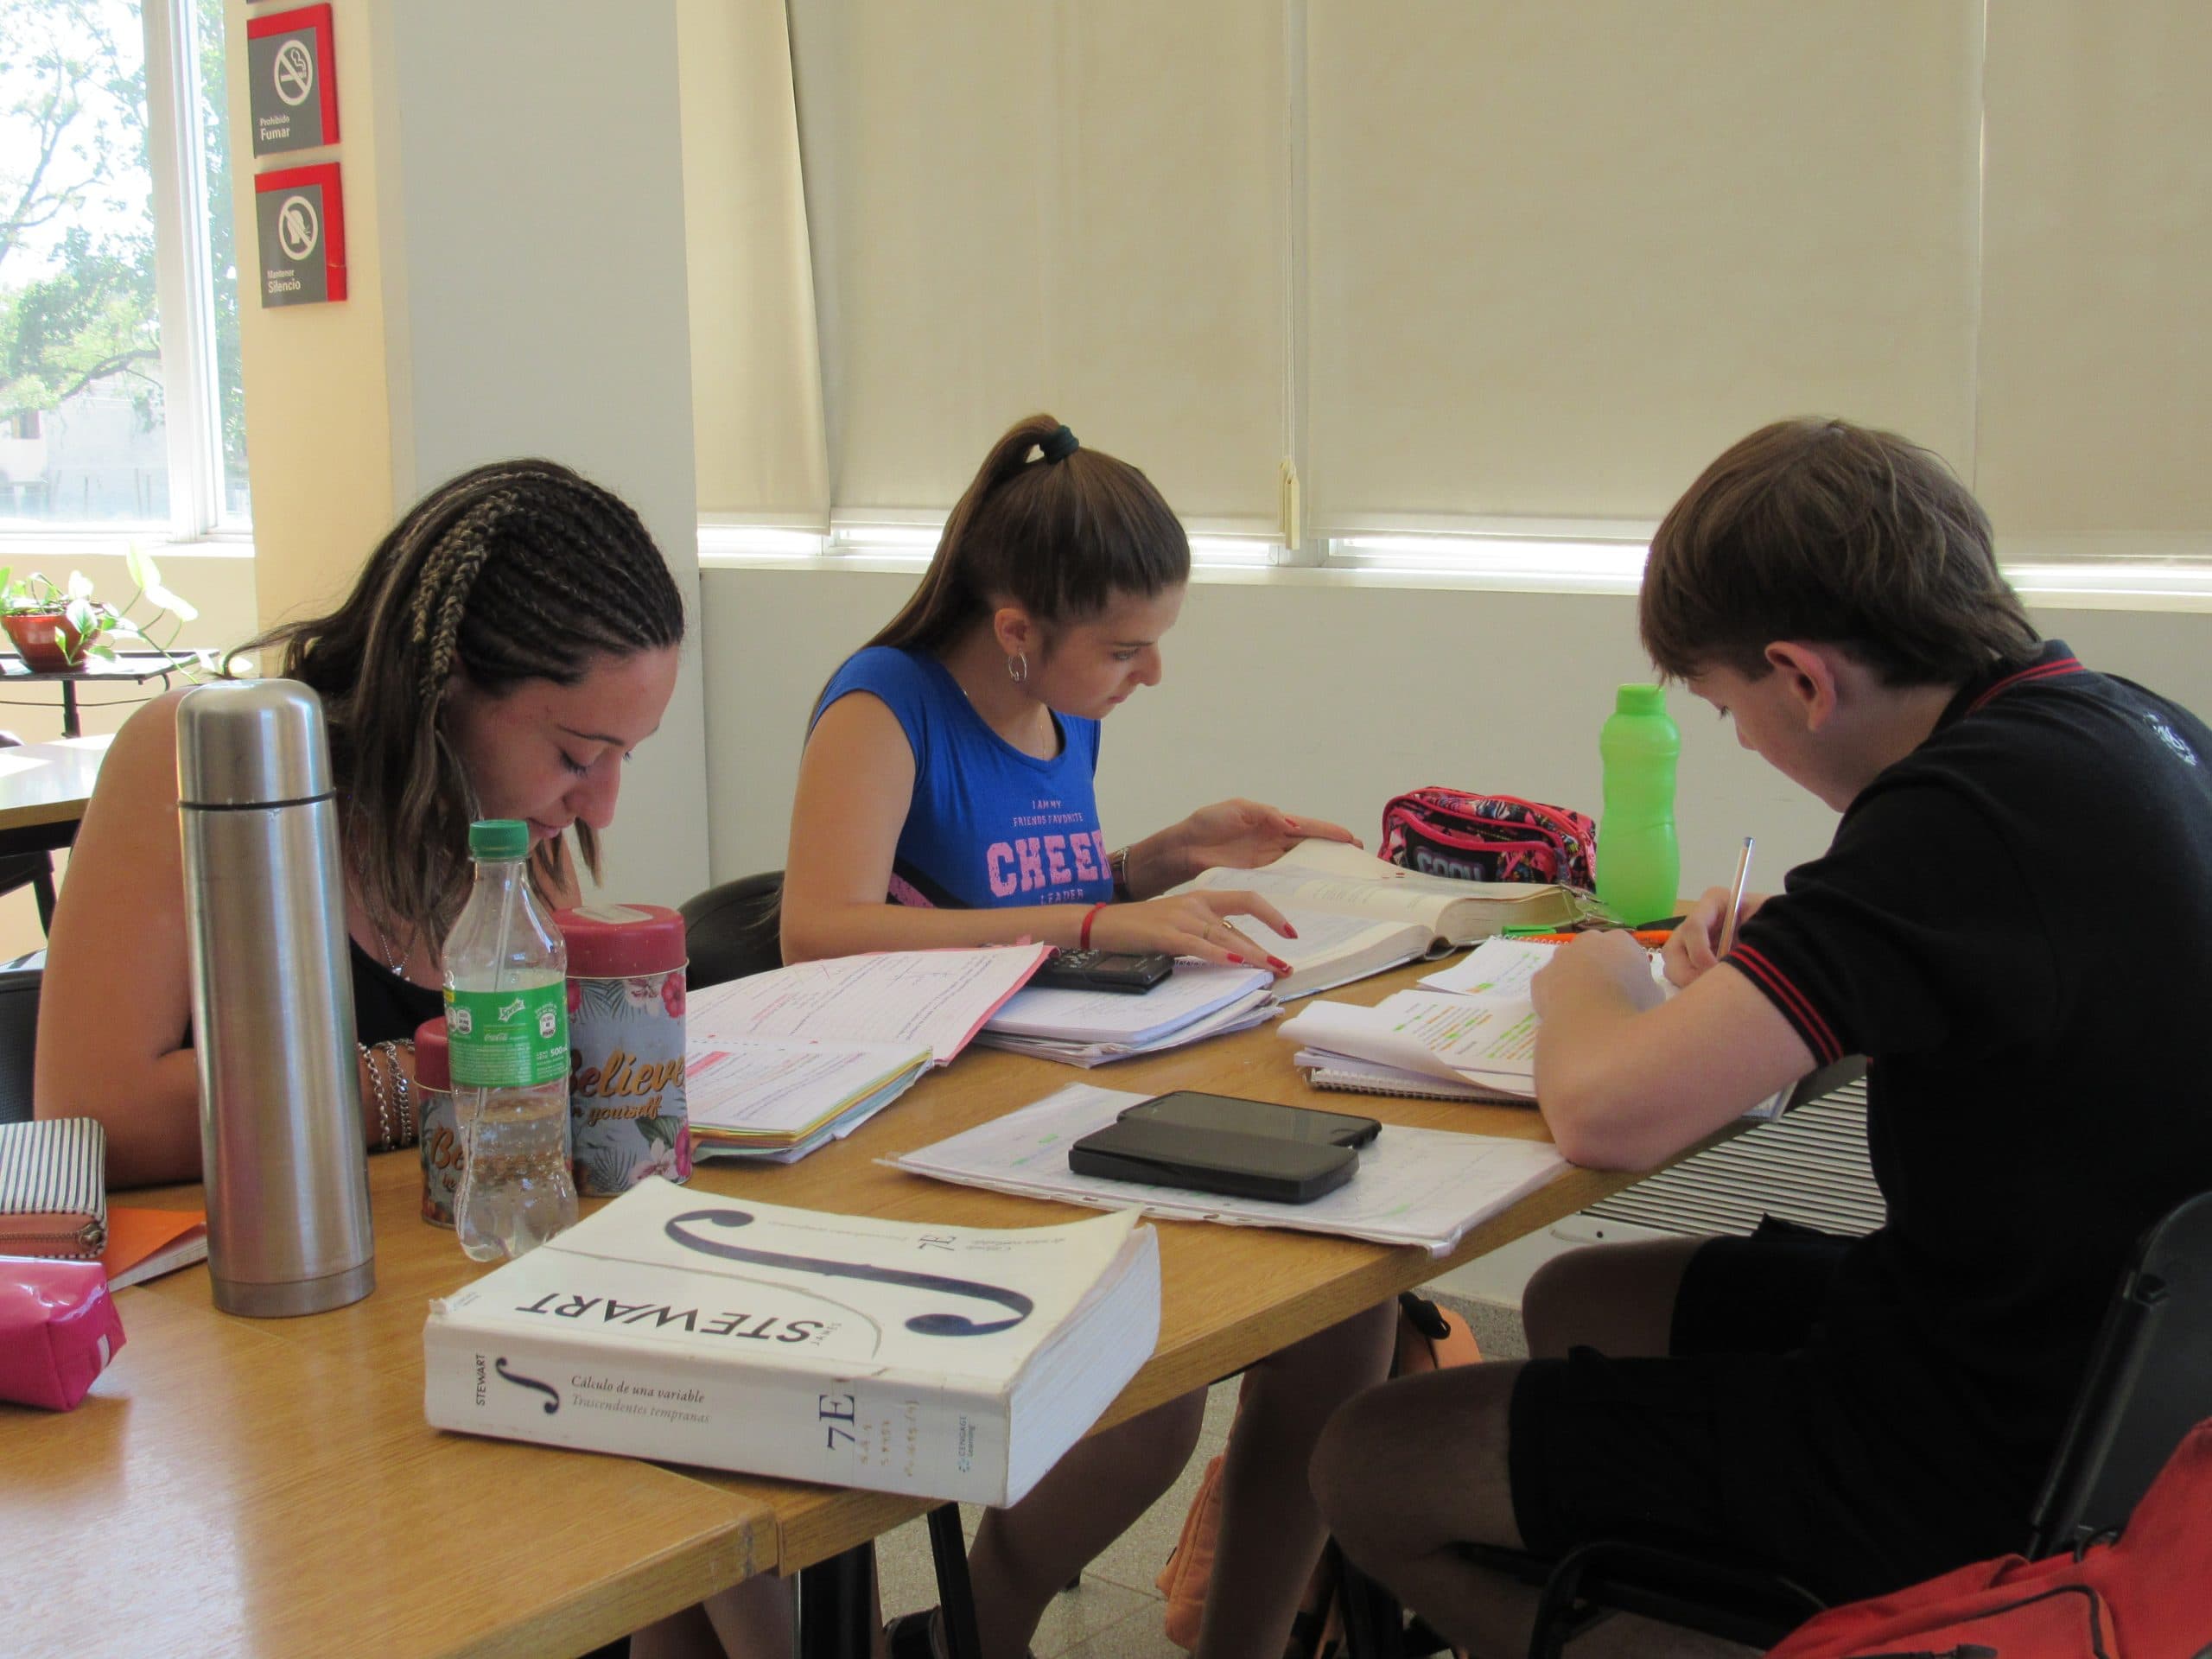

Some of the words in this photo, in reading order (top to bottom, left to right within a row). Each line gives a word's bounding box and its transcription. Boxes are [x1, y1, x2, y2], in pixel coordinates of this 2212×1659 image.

[259, 115, 290, 127] Prohibido
[260, 128, 290, 141] Fumar
[267, 270, 295, 279] Mantener
[268, 278, 302, 294] Silencio
[1037, 799, 1049, 810] AM
[1050, 799, 1062, 809] MY
[1013, 815, 1046, 827] FRIENDS
[1048, 812, 1084, 825] FAVORITE
[1040, 888, 1084, 905] LEADER
[588, 1095, 663, 1127] yourself
[515, 1293, 824, 1343] STEWART
[474, 1353, 487, 1407] STEWART
[571, 1374, 613, 1392] Cálculo
[616, 1380, 630, 1394] de
[632, 1386, 655, 1398] una
[658, 1389, 706, 1404] variable
[572, 1393, 648, 1416] Trascendentes
[650, 1402, 713, 1425] tempranas
[819, 1394, 855, 1451] 7E
[958, 1414, 968, 1457] CENGAGE
